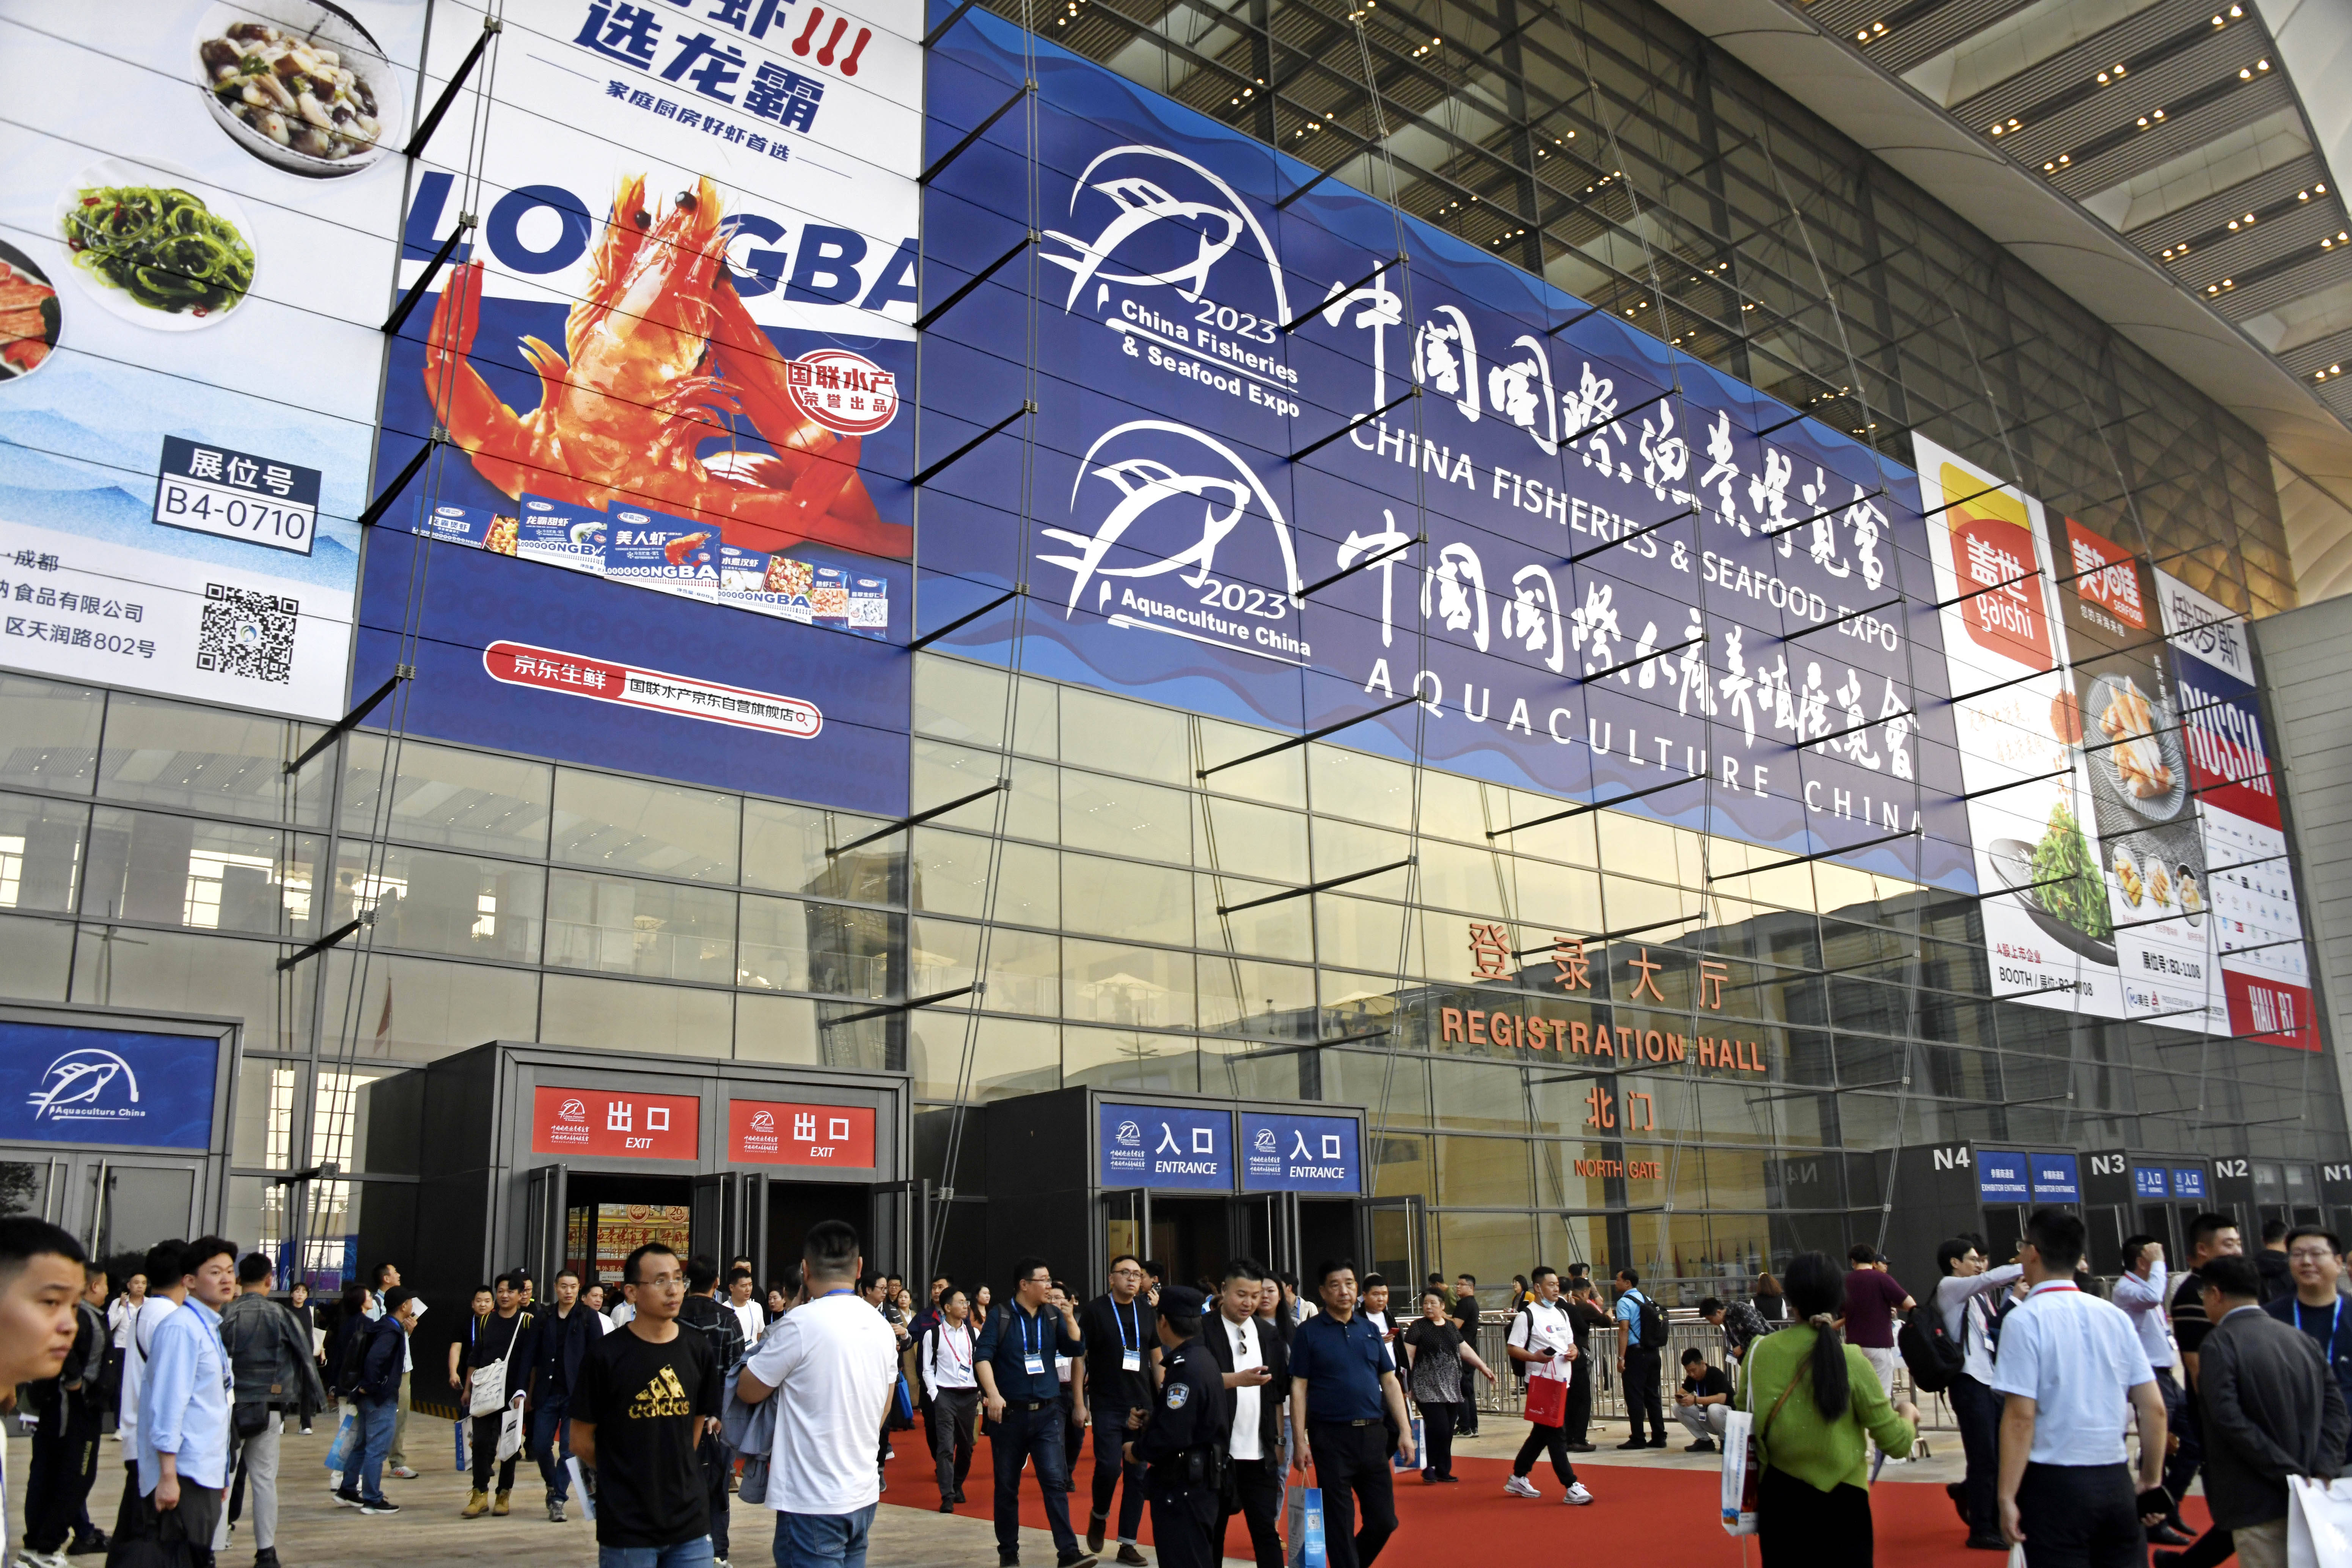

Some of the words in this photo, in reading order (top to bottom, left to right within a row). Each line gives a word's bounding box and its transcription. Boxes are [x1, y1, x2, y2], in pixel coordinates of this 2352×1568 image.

[573, 0, 825, 134] 选龙霸
[605, 79, 790, 162] 家庭厨房好虾首选
[401, 171, 920, 311] LOGBA
[1195, 300, 1276, 344] 2023
[1122, 300, 1189, 342] China
[1197, 330, 1298, 384] Fisheries
[788, 361, 893, 393] 国联水产
[1122, 336, 1139, 357] &
[1148, 346, 1240, 397] Seafood
[1249, 385, 1299, 418] Expo
[804, 392, 887, 413] 荣誉出品
[189, 448, 294, 495] 展位号
[165, 486, 305, 540] B4-0710
[526, 516, 569, 527] 龙霸甜虾
[615, 531, 666, 545] 美人虾
[1350, 414, 1475, 490] CHINA
[1493, 466, 1657, 559] FISHERIES
[1671, 540, 1689, 572] &
[1703, 551, 1826, 624] SEAFOOD
[1838, 605, 1898, 652] EXPO
[1966, 532, 2028, 603] 盖世
[1200, 580, 1287, 619] 2023
[2113, 600, 2142, 622] SEAFOOD
[1122, 589, 1249, 639] Aquaculture
[1255, 627, 1311, 657] China
[1976, 593, 2034, 639] gaishi
[5, 616, 156, 658] 区天润路802号
[514, 655, 606, 690] 京东生鲜
[630, 678, 794, 722] 国联水产京东自营旗舰店
[1364, 658, 1768, 798] AQUACULTURE
[1805, 781, 1925, 840] CHINA
[2179, 680, 2273, 797] RUSSIA
[1469, 924, 1728, 1009] 登录大厅
[1997, 943, 2041, 964] A股上市企业
[1999, 966, 2032, 987] BOOTH
[2248, 985, 2281, 1035] HALL
[1441, 1007, 1684, 1062] REGISTRATION
[1697, 1037, 1766, 1071] HALL
[55, 1106, 115, 1117] Aquaculture
[119, 1108, 146, 1117] China
[608, 1101, 669, 1132] 出口
[1586, 1088, 1654, 1131] 北门
[793, 1112, 849, 1142] 出口
[1155, 1122, 1213, 1155] 入口
[625, 1137, 653, 1149] EXIT
[810, 1147, 835, 1158] EXIT
[1290, 1130, 1340, 1161] 入口
[1933, 1147, 1970, 1170] N4
[1155, 1161, 1217, 1174] ENTRANCE
[1290, 1166, 1345, 1178] ENTRANCE
[1574, 1160, 1623, 1178] NORTH
[1628, 1161, 1663, 1179] GATE
[2091, 1155, 2125, 1175] N3
[2148, 1172, 2162, 1185] 入口
[2185, 1173, 2198, 1186] 入口
[2215, 1160, 2249, 1178] N2
[2324, 1164, 2352, 1181] N1
[670, 1206, 682, 1215] 26
[628, 1398, 690, 1419] adidas
